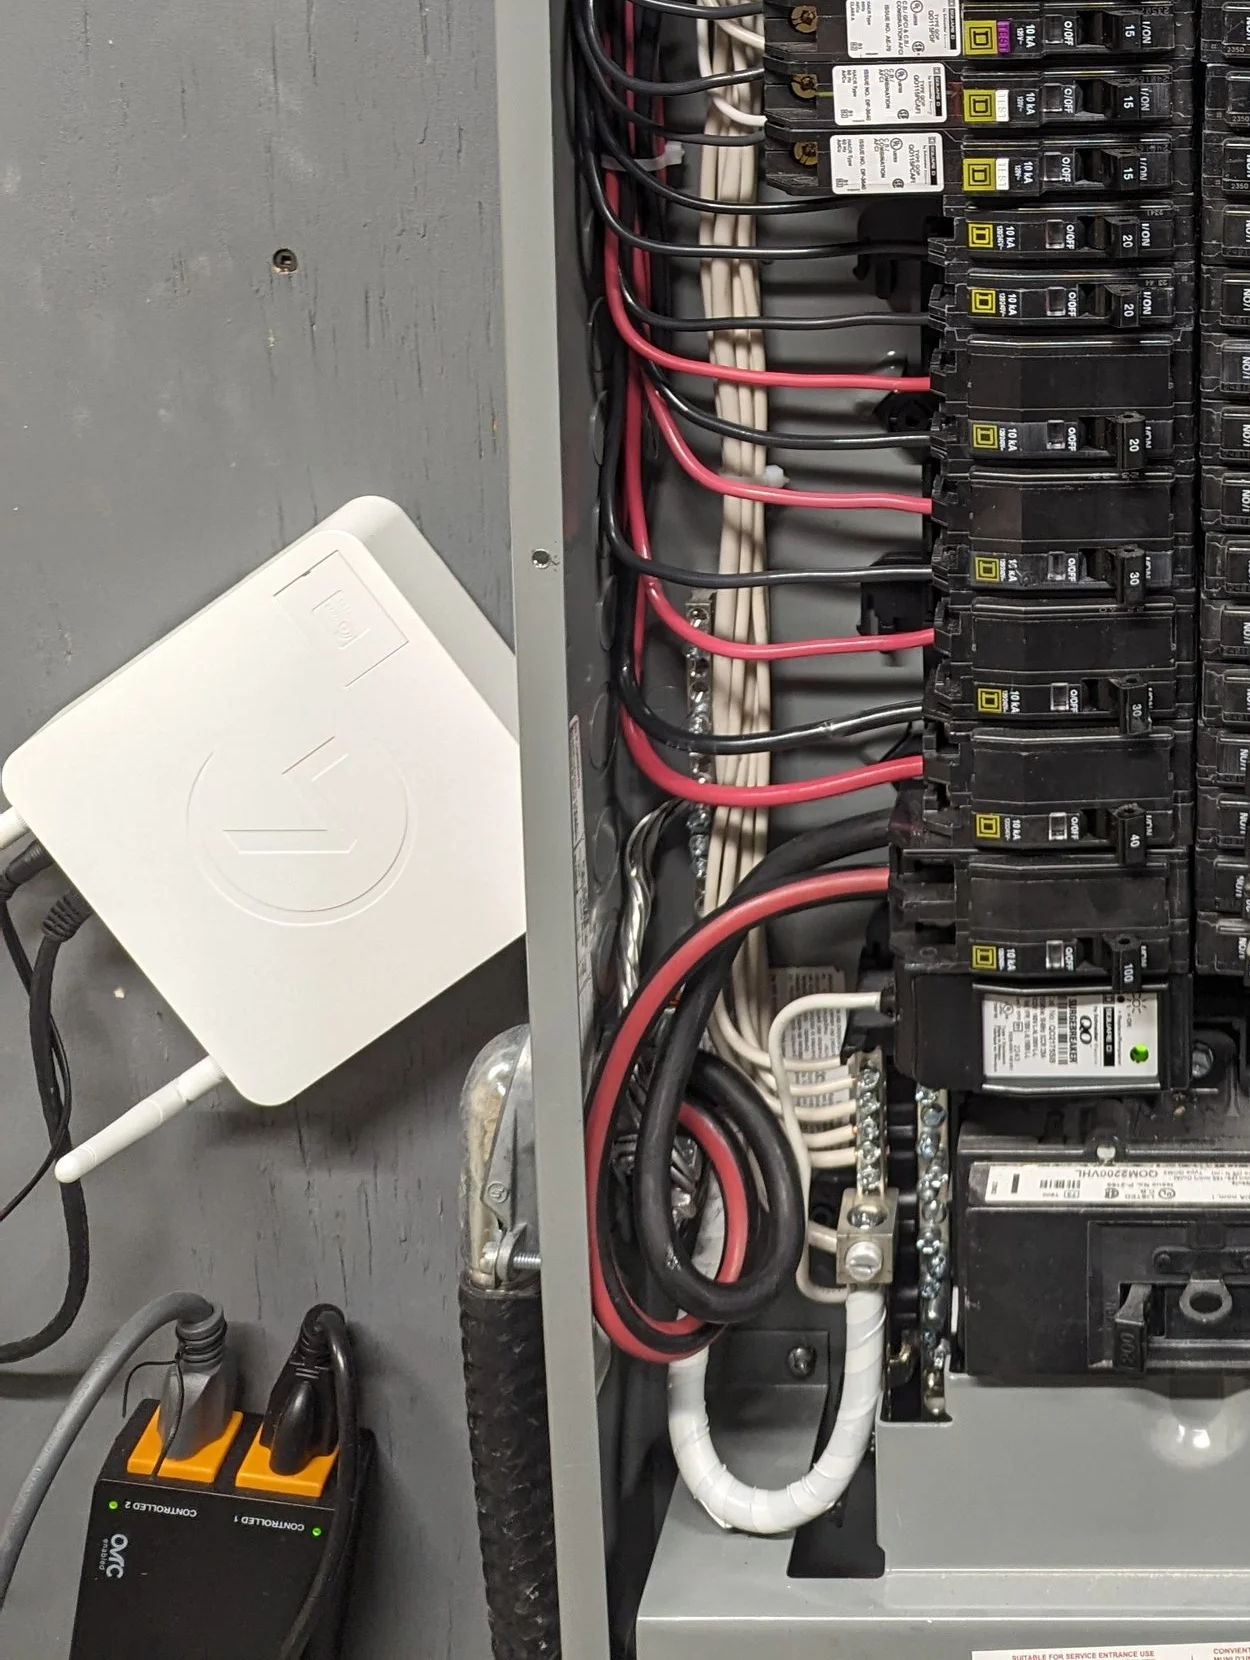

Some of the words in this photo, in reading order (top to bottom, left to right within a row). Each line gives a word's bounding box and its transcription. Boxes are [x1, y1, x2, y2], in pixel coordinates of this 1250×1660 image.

[1125, 24, 1134, 37] 15
[1123, 96, 1133, 109] 15
[1123, 167, 1133, 180] 15
[1123, 234, 1133, 247] 20
[1123, 303, 1134, 317] 20
[1129, 438, 1139, 452] 20
[1129, 572, 1139, 585] 30
[1132, 704, 1142, 716] 30
[1129, 834, 1139, 847] 40
[1123, 964, 1134, 983] 100
[1069, 998, 1078, 1063] SURGEBREAKER
[1079, 1015, 1092, 1045] QO
[125, 1501, 131, 1509] 2
[133, 1502, 197, 1517] CONTROLLED
[241, 1516, 304, 1531] CONTROLLED
[1099, 1651, 1137, 1659] ENTRANCE
